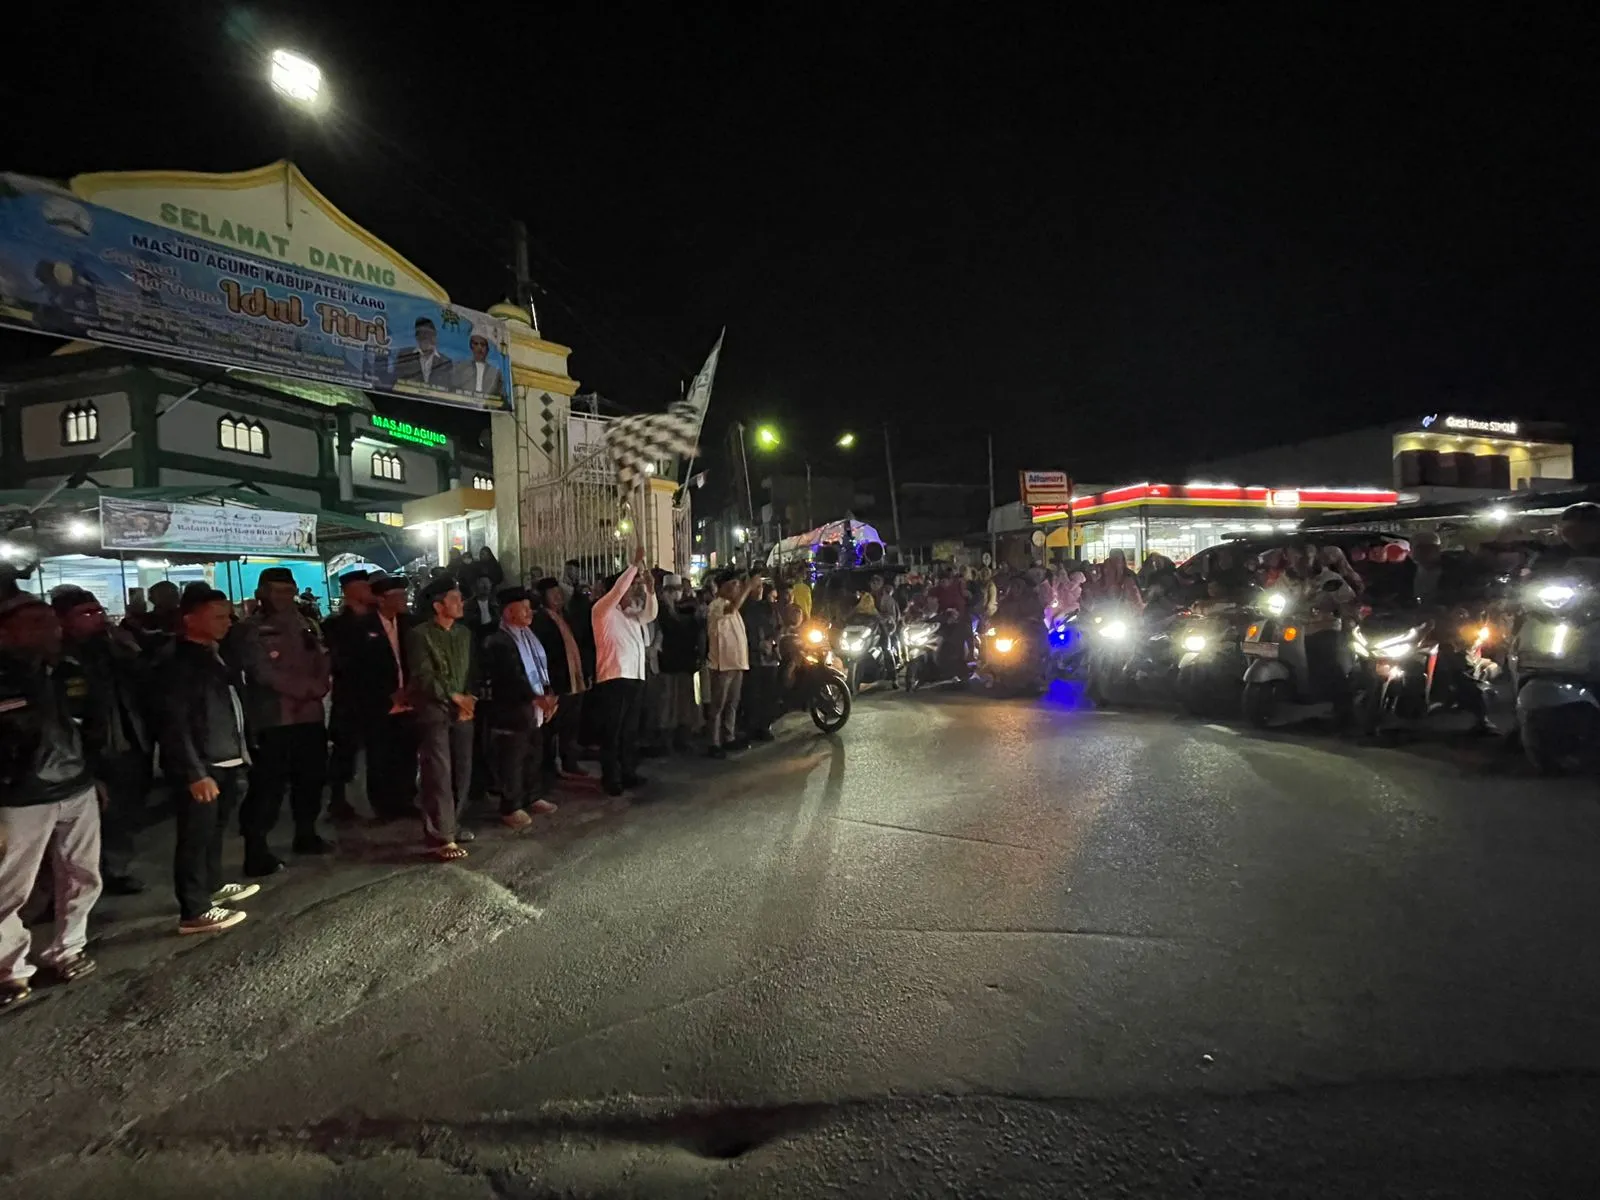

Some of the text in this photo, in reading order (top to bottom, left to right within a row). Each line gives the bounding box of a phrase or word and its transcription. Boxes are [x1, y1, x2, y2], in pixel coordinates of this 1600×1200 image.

[132, 235, 200, 263] MASJID
[206, 253, 259, 280] AGUNG
[265, 269, 347, 302] KABUPATEN
[352, 291, 386, 310] KARO
[160, 203, 290, 257] SELAMAT
[309, 246, 396, 287] DATANG
[219, 278, 309, 327] Idul
[315, 302, 391, 346] Fitri
[372, 414, 446, 444] MASJID AGUNG
[1468, 419, 1489, 430] House
